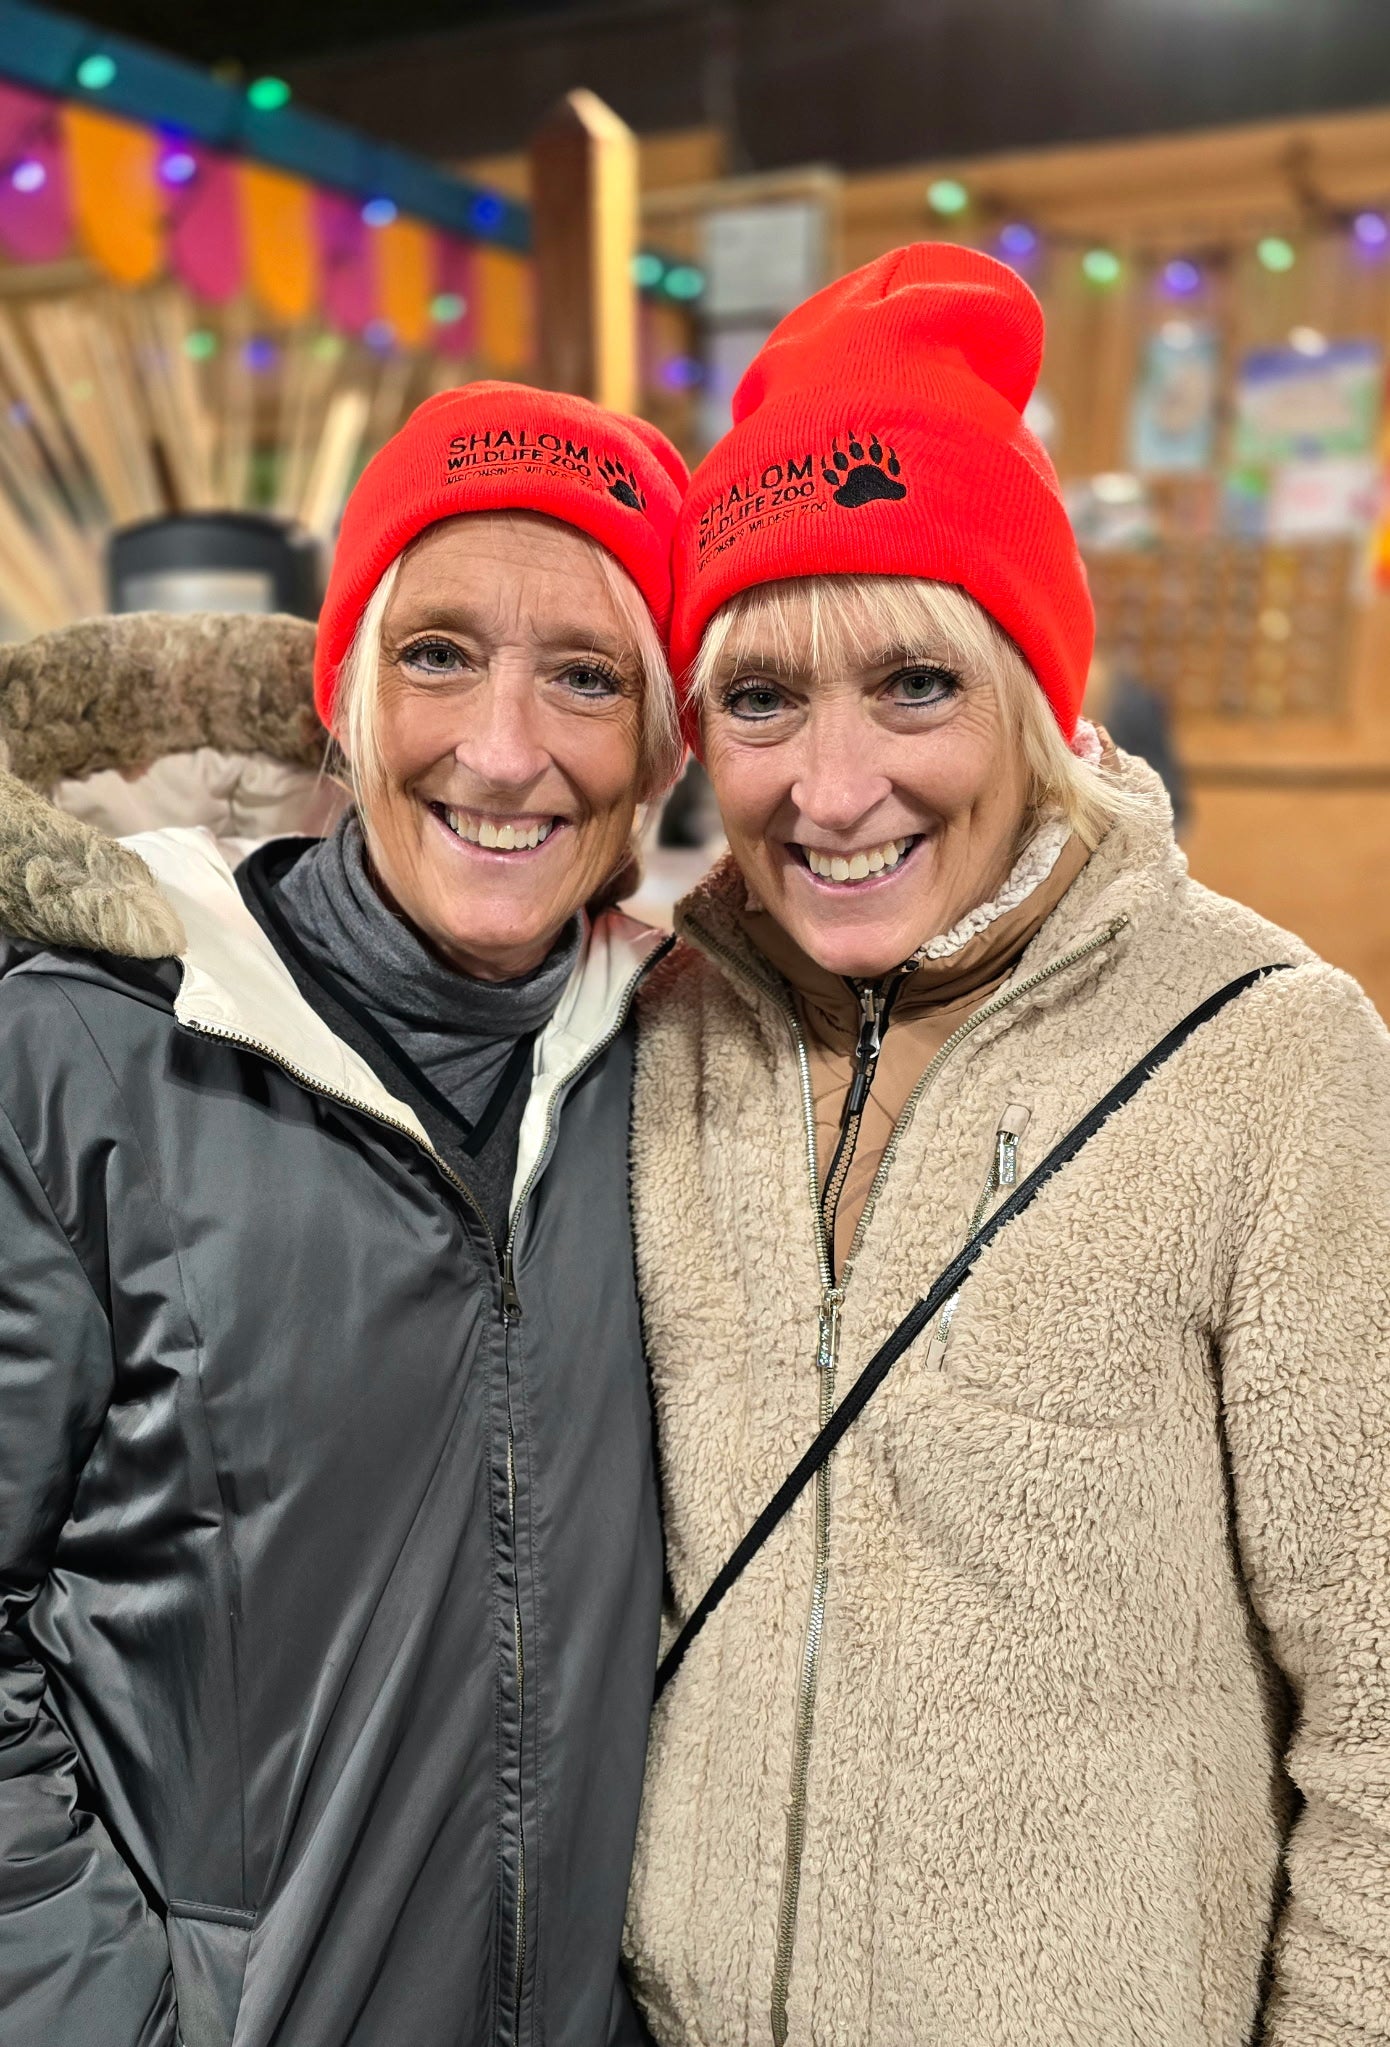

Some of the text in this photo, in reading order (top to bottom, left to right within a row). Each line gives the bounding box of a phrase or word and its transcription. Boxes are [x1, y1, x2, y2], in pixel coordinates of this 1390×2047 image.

[447, 449, 591, 477] WILDLIFE ZOO
[449, 430, 589, 464] SHALOM
[700, 454, 813, 535] SHALOM
[801, 501, 828, 516] ZOO
[698, 481, 815, 552] WILDLIFE ZOO
